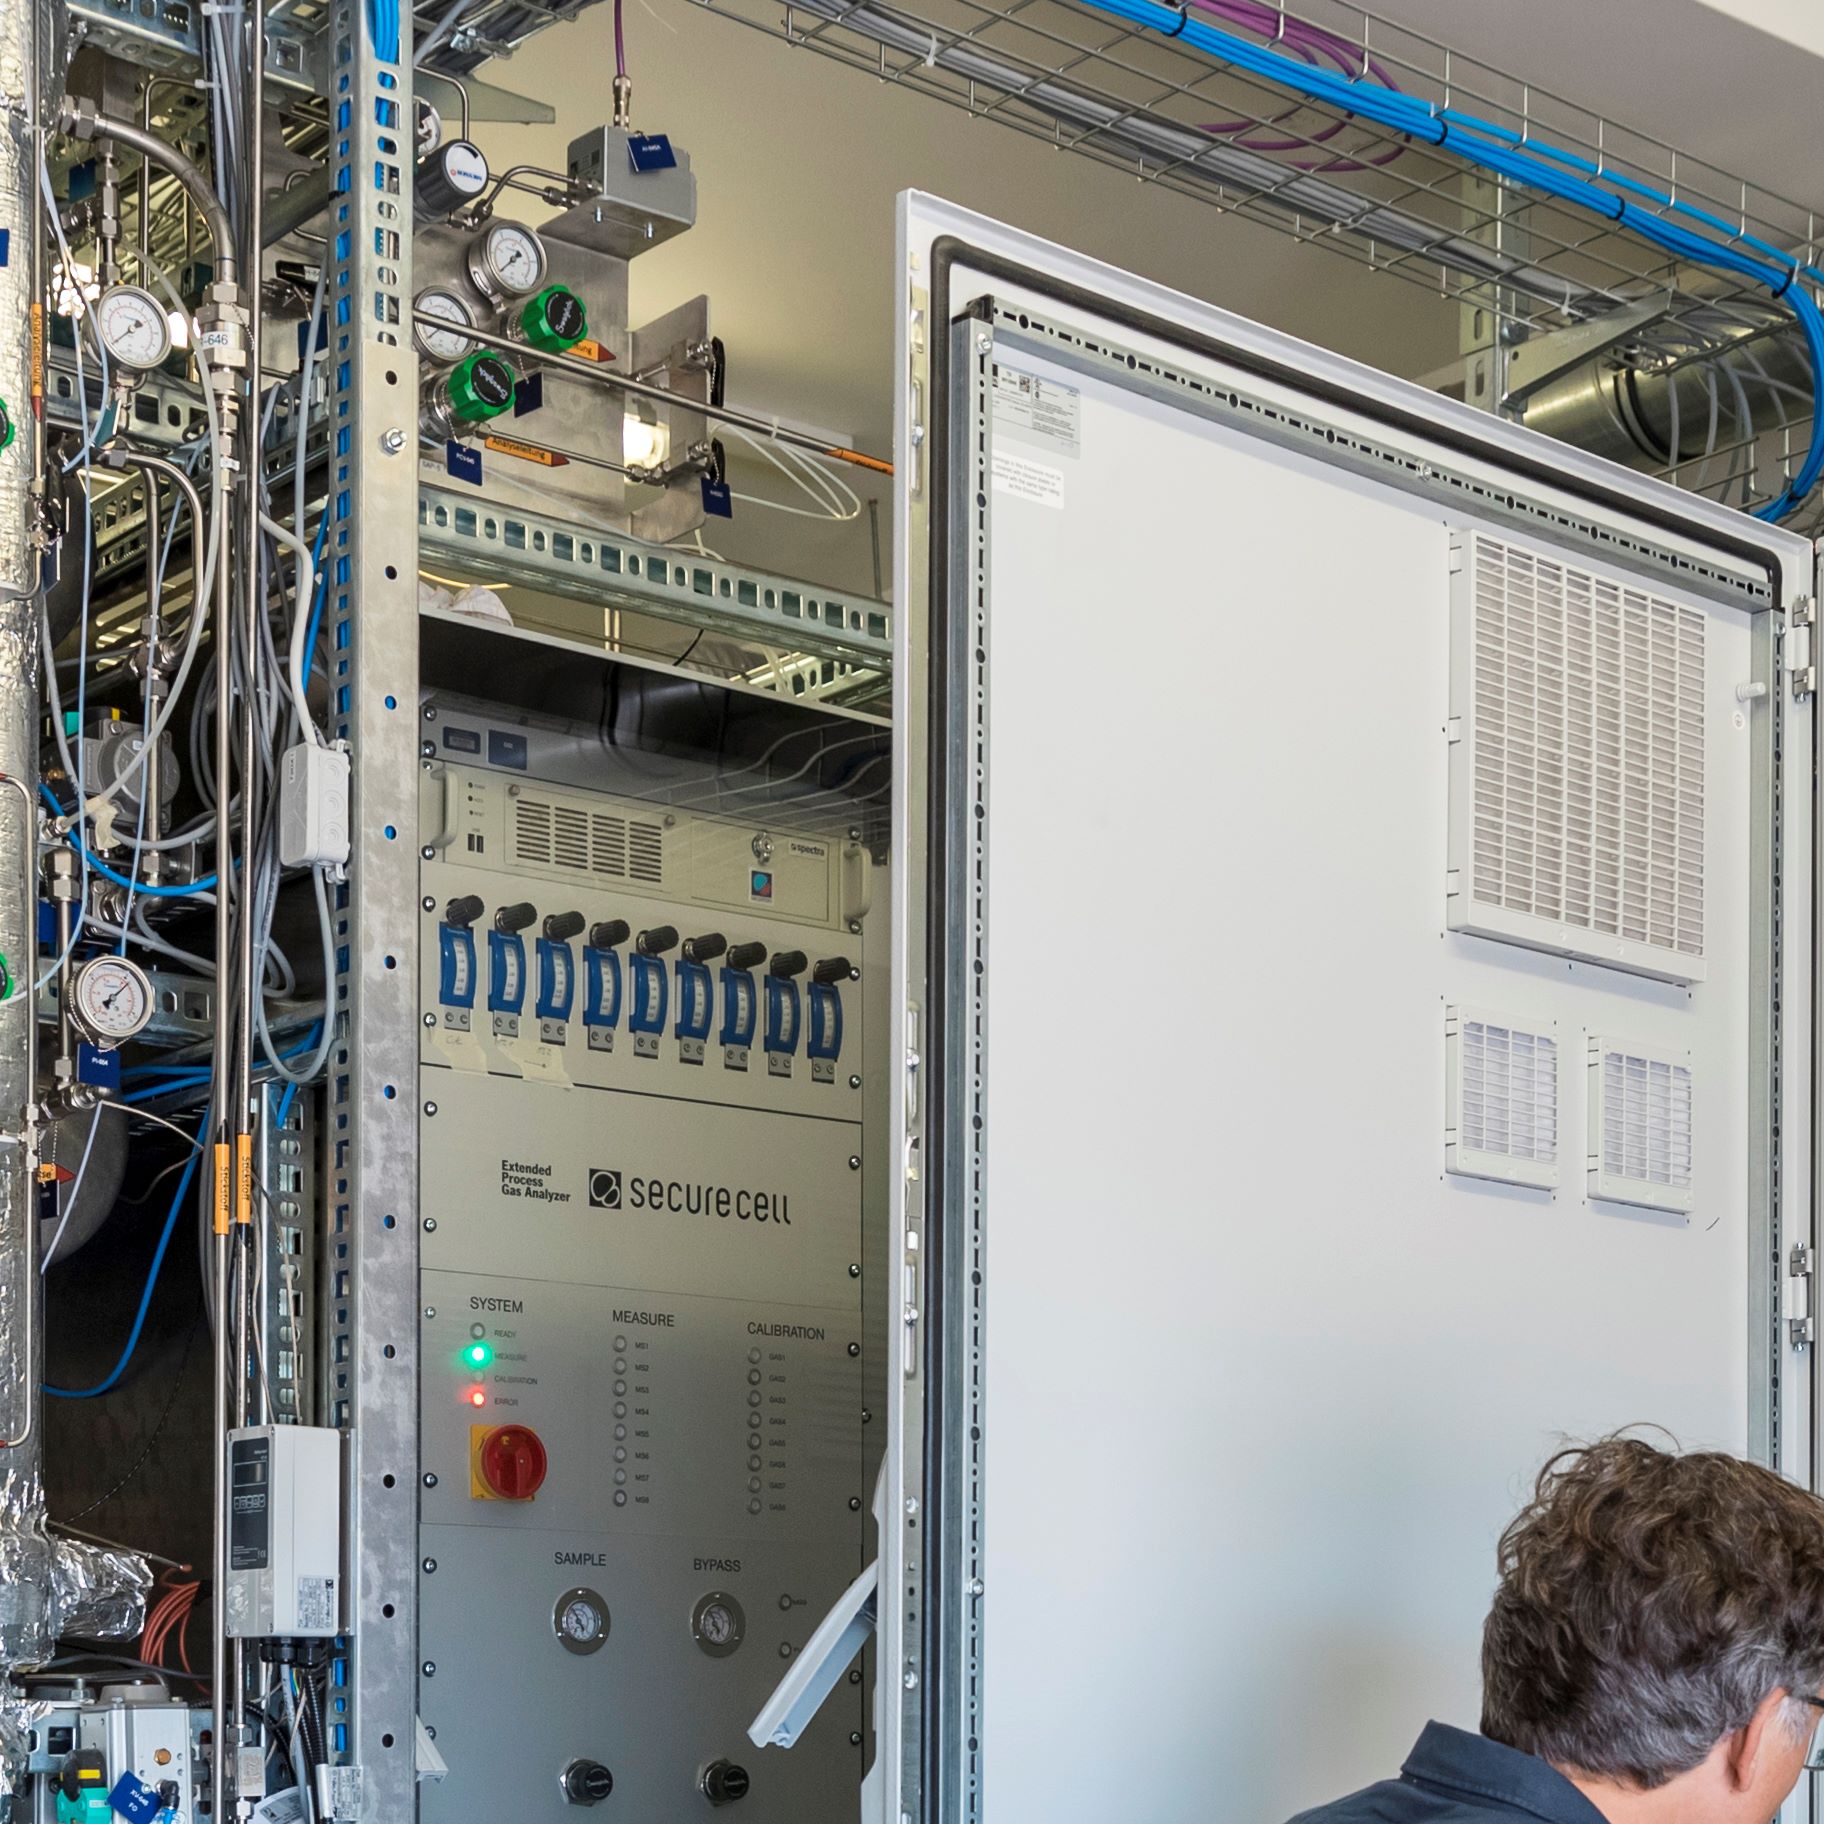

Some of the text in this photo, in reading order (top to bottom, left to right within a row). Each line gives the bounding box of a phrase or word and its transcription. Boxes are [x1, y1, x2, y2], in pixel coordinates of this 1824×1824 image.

[501, 1159, 552, 1176] Extended
[241, 1156, 252, 1204] Stickstoff
[501, 1172, 544, 1188] Process
[220, 1166, 230, 1214] Stickstoff
[501, 1184, 571, 1203] Gas Analyzer
[630, 1178, 792, 1225] securecell
[470, 1296, 524, 1314] SYSTEM
[612, 1310, 674, 1328] MEASURE
[494, 1330, 516, 1339] READY
[747, 1322, 824, 1341] CALIBRATION
[494, 1375, 538, 1385] CALIBRATION
[494, 1398, 518, 1406] ERROR
[554, 1551, 607, 1567] SAMPLE
[693, 1558, 742, 1573] BYPASS
